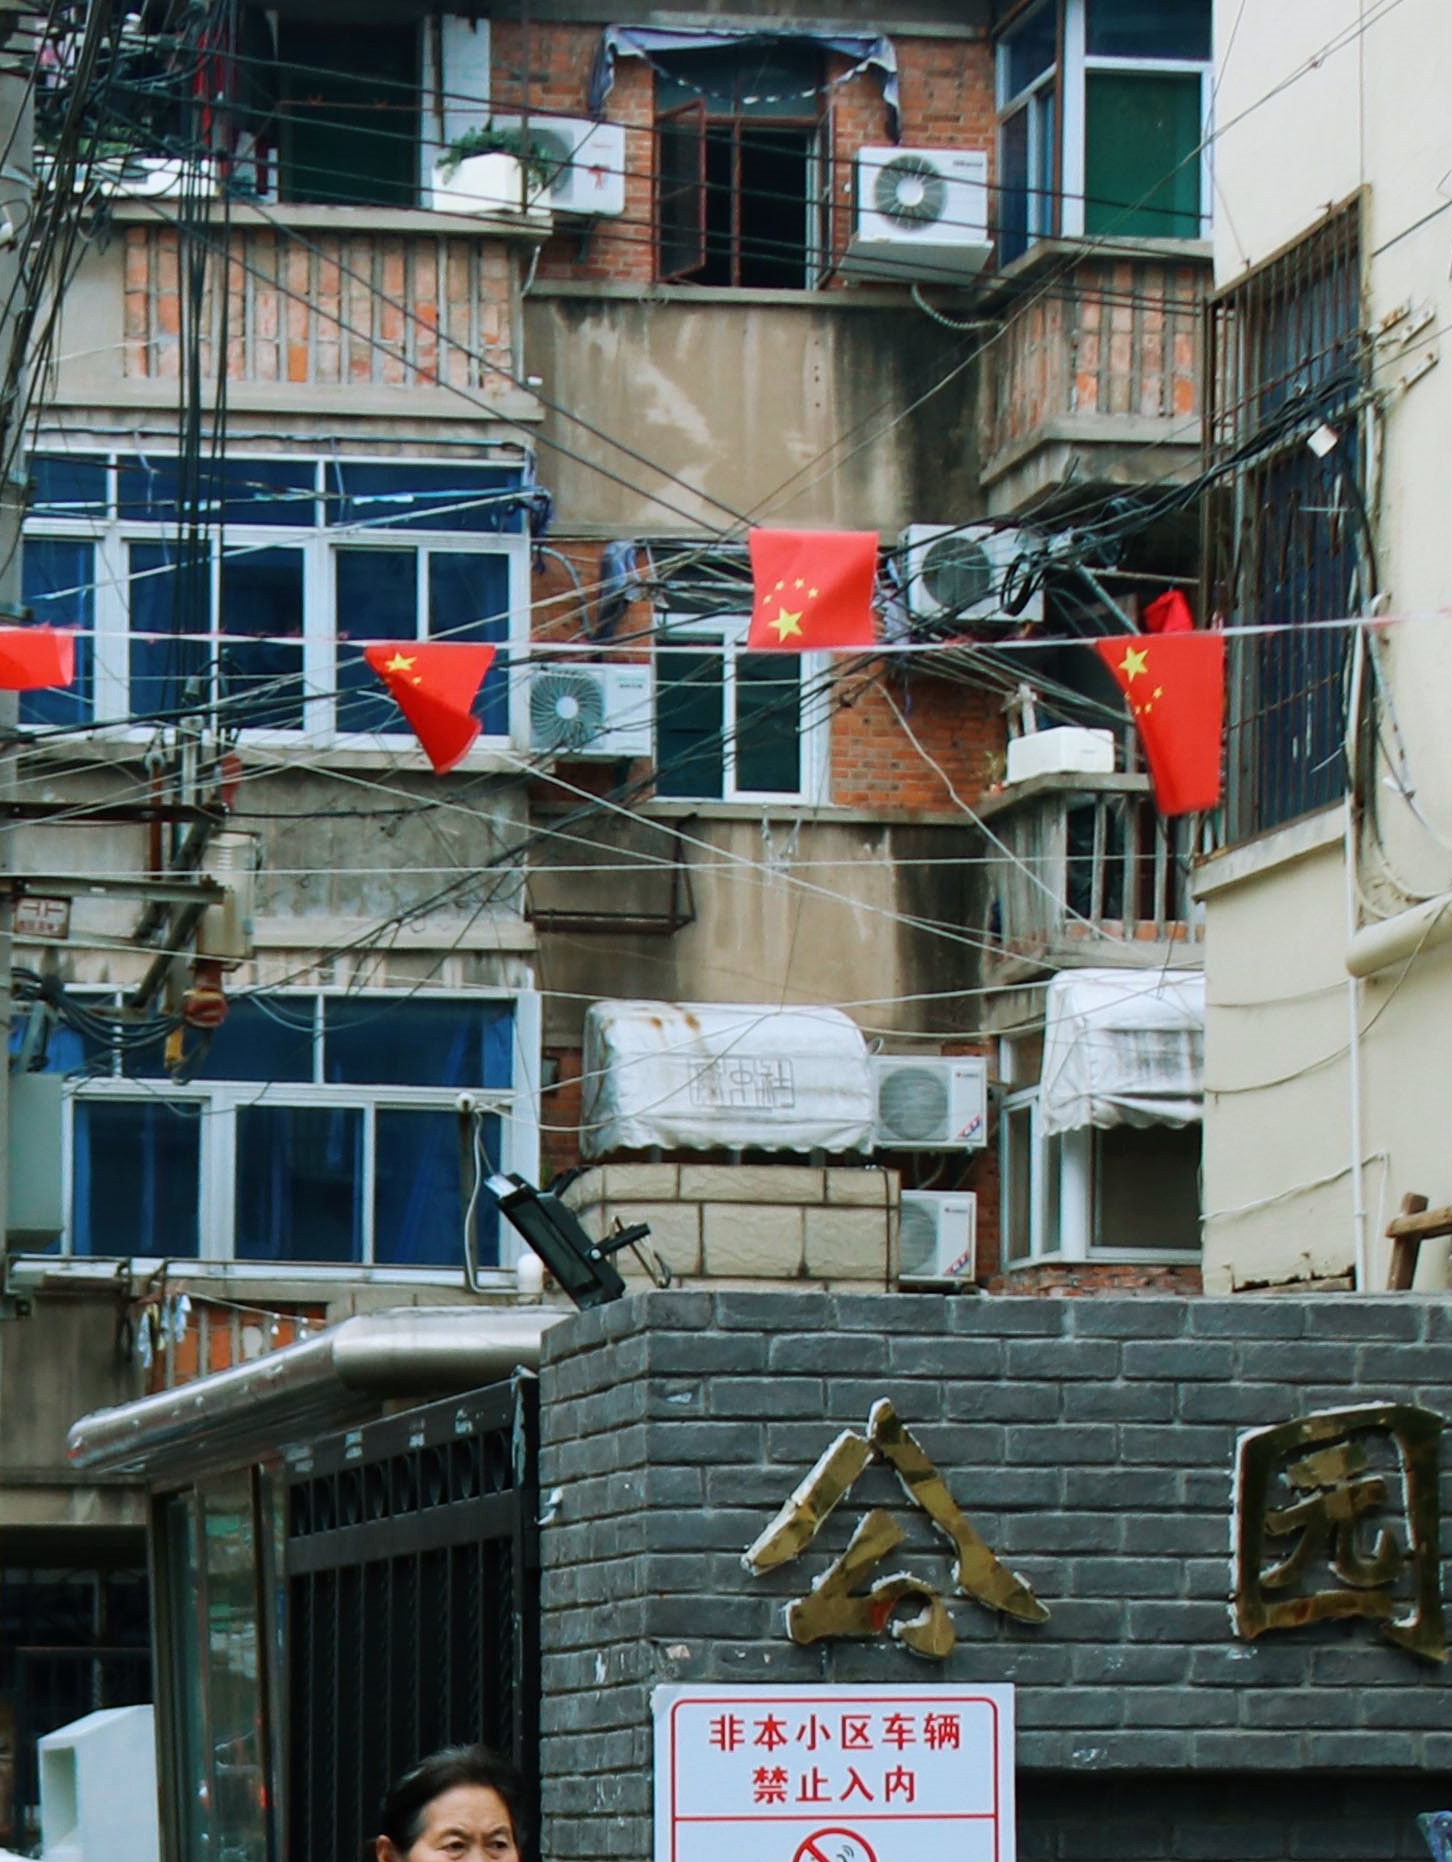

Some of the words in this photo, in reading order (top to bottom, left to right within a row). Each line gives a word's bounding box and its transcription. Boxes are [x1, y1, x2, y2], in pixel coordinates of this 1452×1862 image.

[707, 1711, 963, 1753] 非本小区车辆
[751, 1764, 917, 1804] 禁止入内
